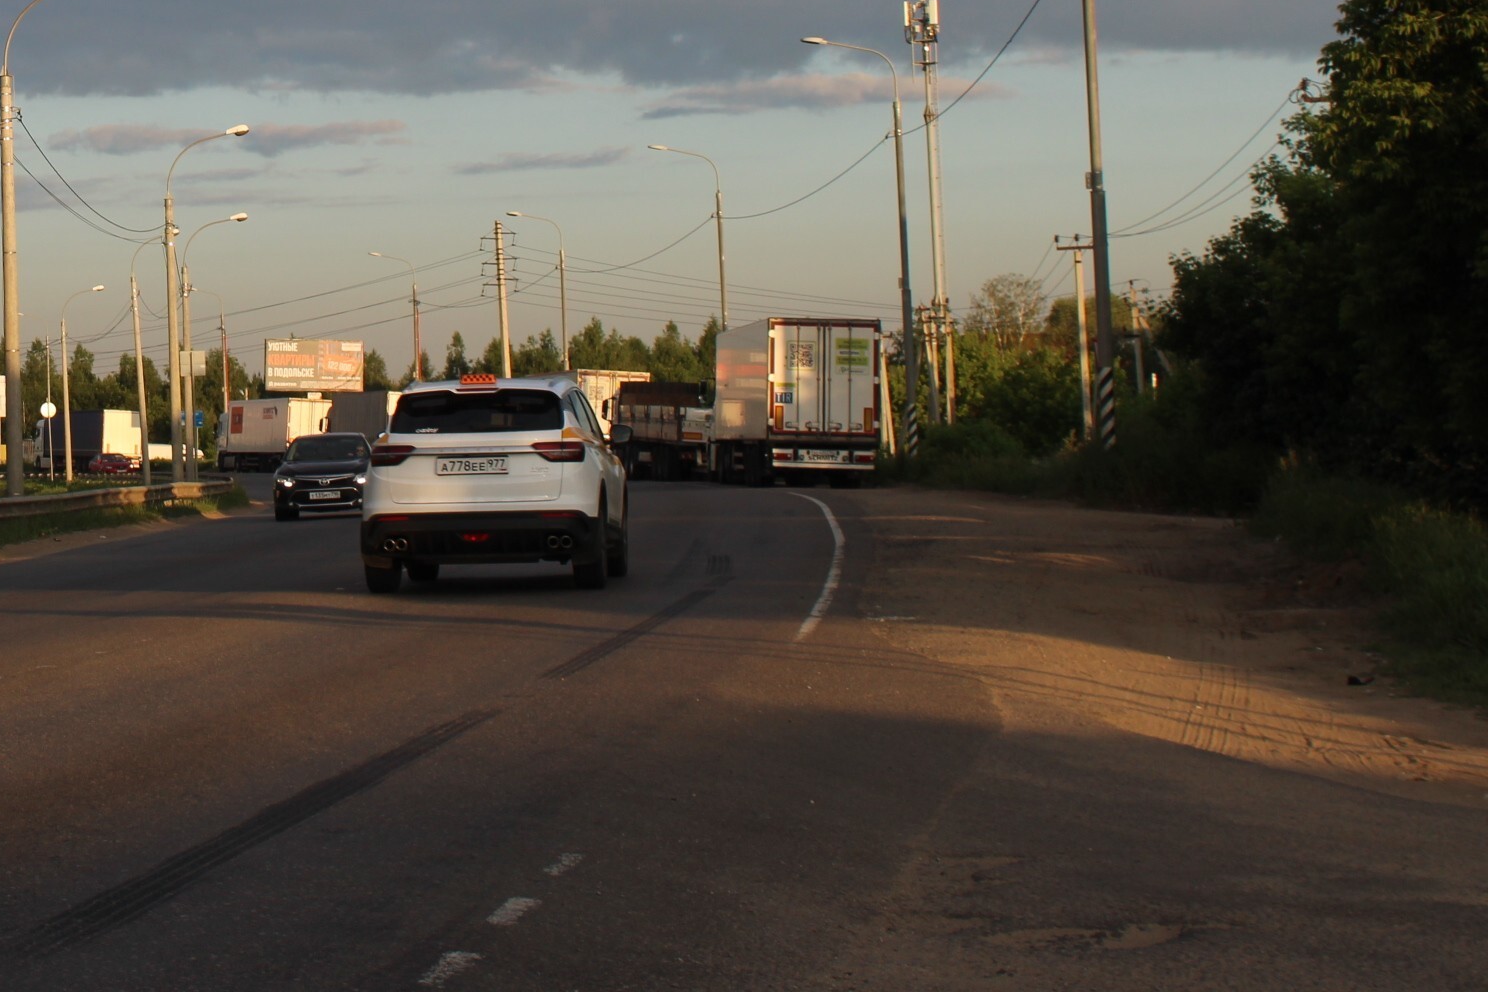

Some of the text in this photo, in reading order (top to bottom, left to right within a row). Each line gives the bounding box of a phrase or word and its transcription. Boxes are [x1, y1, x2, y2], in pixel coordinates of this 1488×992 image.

[268, 342, 298, 352] УЮТНЫЕ
[268, 353, 315, 367] КВАРТИРЫ
[274, 368, 314, 378] ПОДОЛЬСКЕ
[776, 393, 792, 404] TIR
